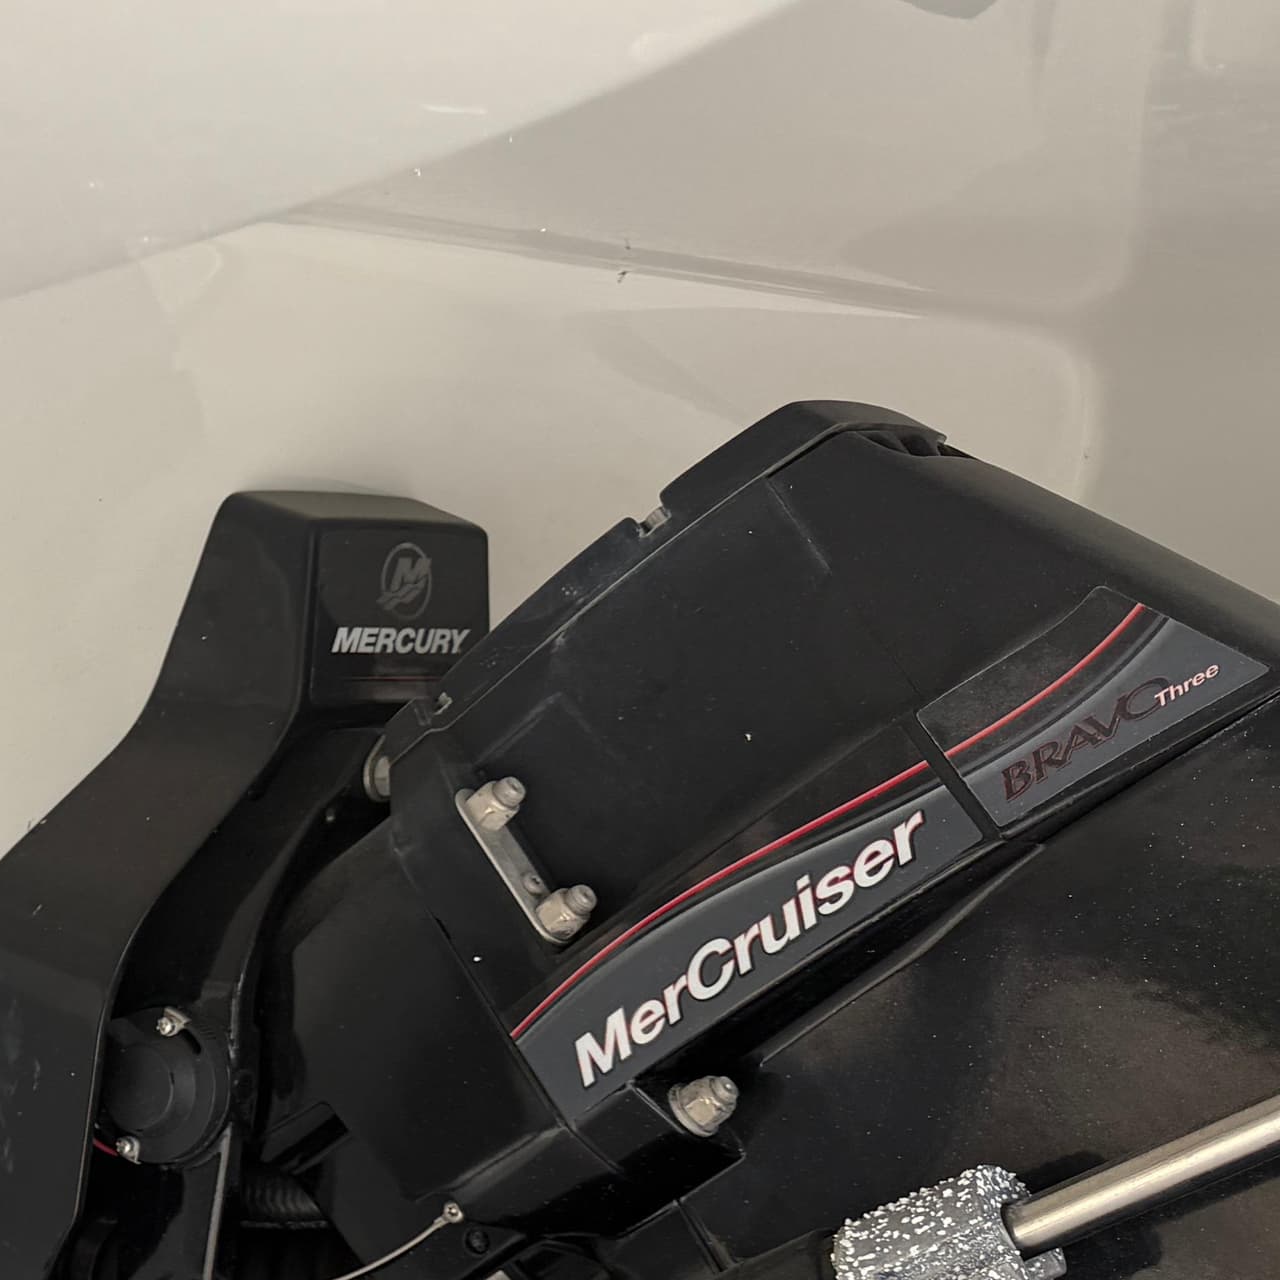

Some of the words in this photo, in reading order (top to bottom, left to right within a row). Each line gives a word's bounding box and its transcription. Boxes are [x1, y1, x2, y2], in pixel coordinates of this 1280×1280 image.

[331, 627, 471, 655] MERCURY
[999, 675, 1172, 802] BRAVO
[1154, 662, 1221, 707] Three
[573, 809, 925, 1089] MerCruiser
